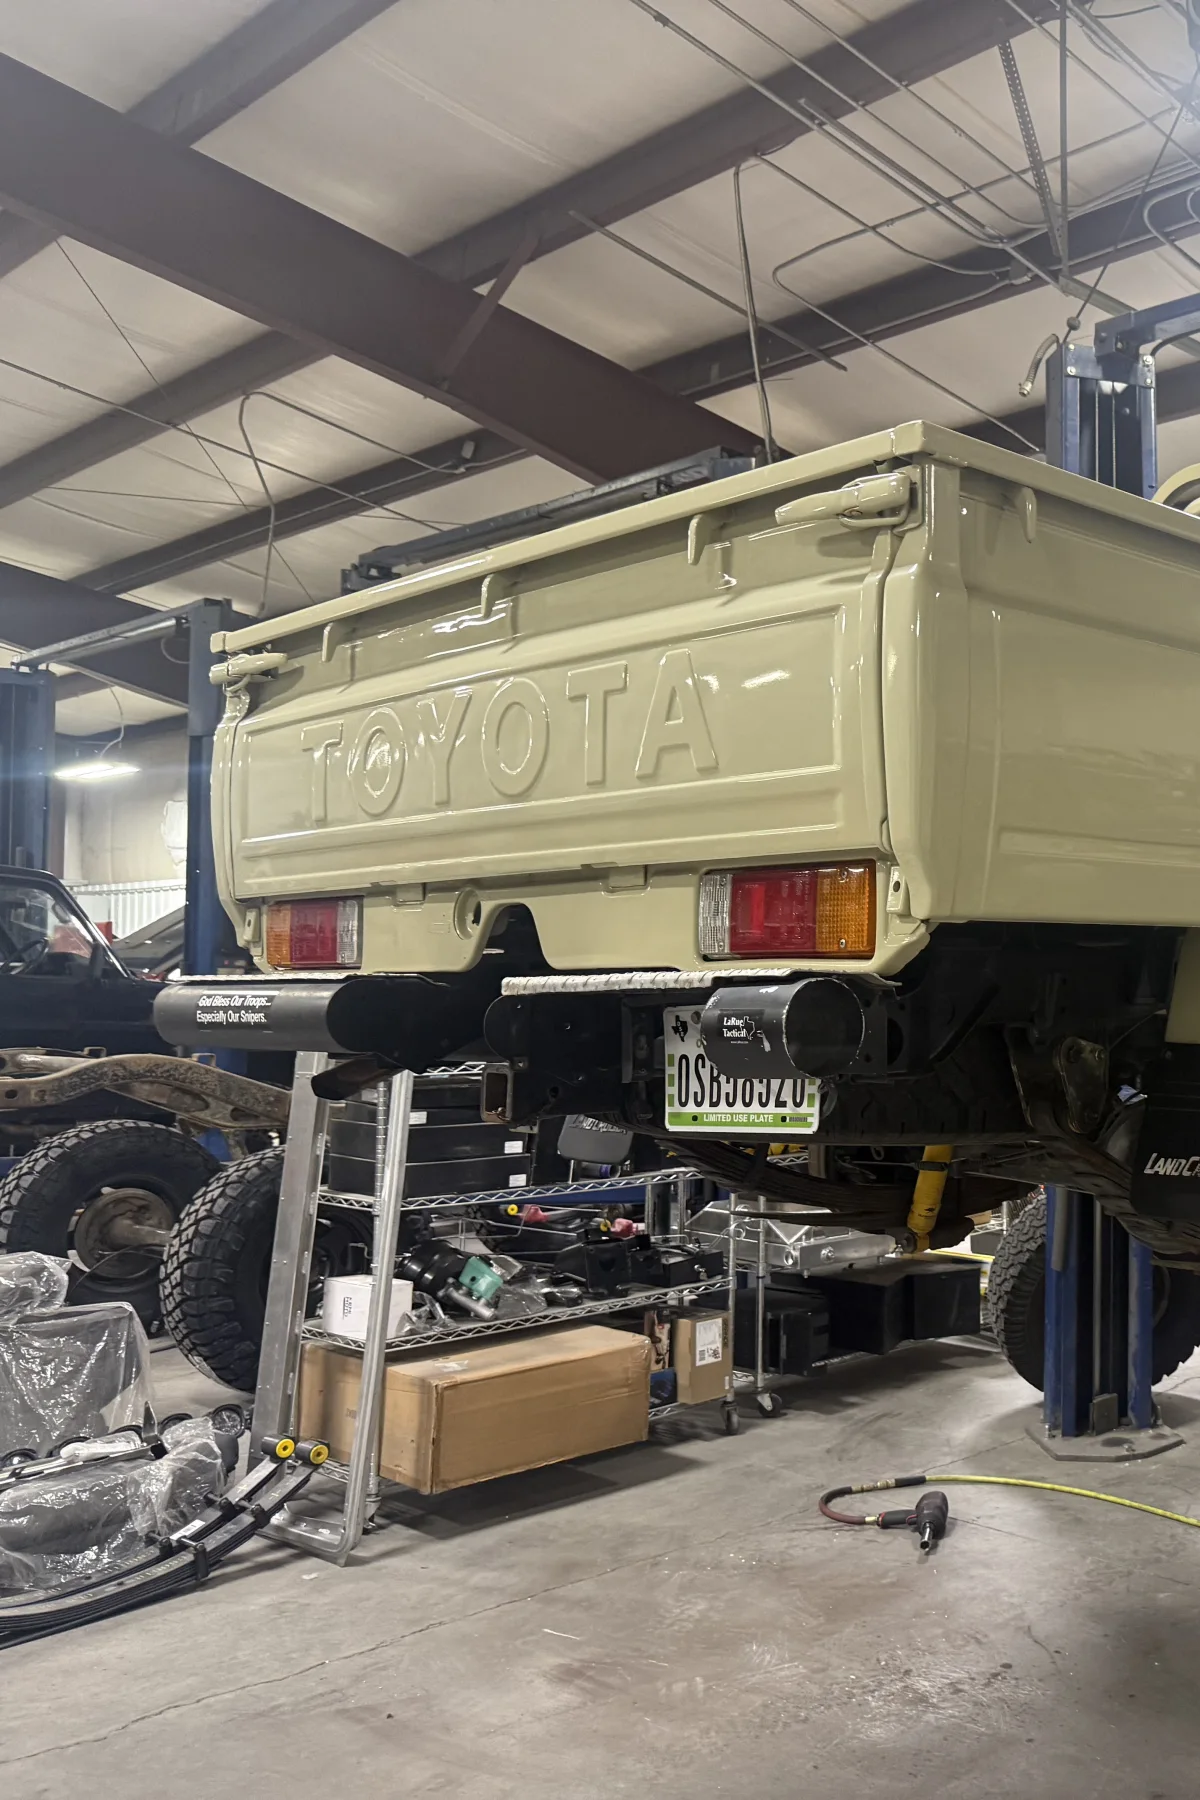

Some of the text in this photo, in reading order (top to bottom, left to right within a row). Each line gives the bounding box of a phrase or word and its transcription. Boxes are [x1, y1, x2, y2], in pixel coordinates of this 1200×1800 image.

[301, 647, 719, 822] TOYOTA
[197, 995, 212, 1007] God
[212, 995, 231, 1007] Bless
[231, 995, 244, 1007] Our
[196, 1010, 267, 1025] Especially Our Snipers.
[723, 1016, 744, 1027] LaRue
[722, 1028, 747, 1038] Tactical
[703, 1113, 774, 1123] LIMITED USE PLATE
